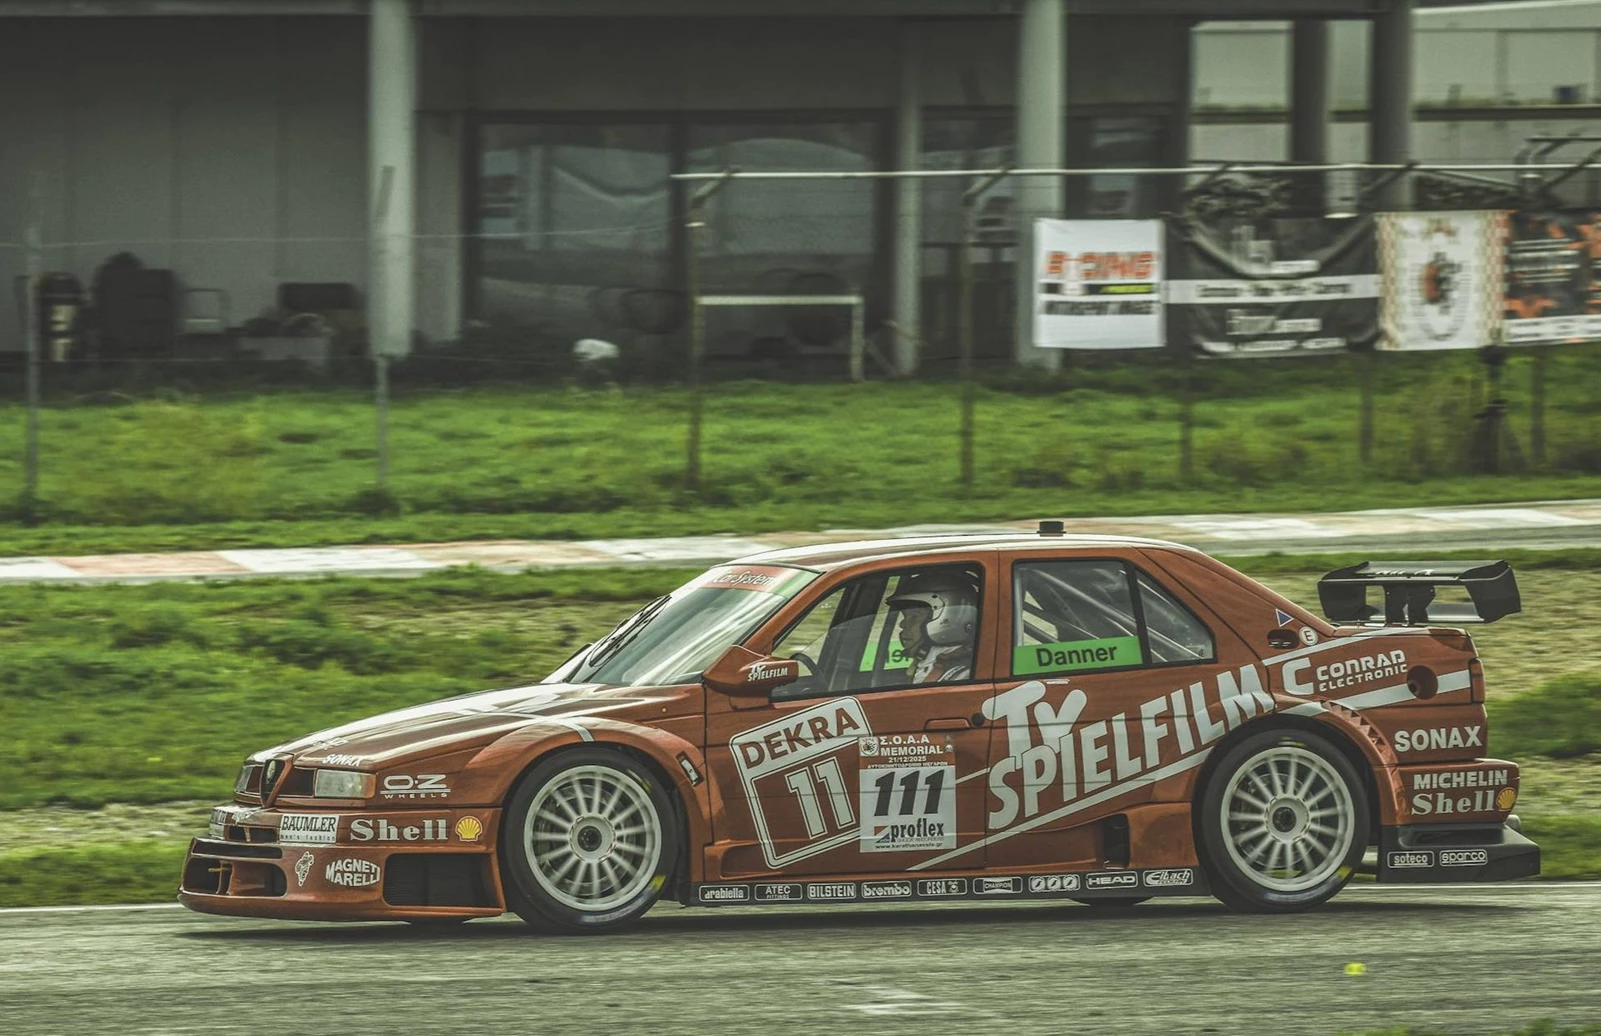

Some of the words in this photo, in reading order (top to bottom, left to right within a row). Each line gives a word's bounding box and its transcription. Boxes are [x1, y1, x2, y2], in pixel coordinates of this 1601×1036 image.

[1036, 645, 1117, 667] Danner
[1316, 649, 1406, 681] CONRAD
[748, 667, 788, 682] SPIELFILM
[1319, 664, 1408, 692] ELECTRONIC
[982, 681, 1087, 769] TV
[739, 707, 860, 769] DEKRA
[988, 664, 1276, 830] SPIELFILM
[1394, 725, 1483, 752] SONAX
[880, 745, 943, 756] MEMORIAL
[1413, 770, 1508, 790] MICHELIN
[785, 757, 856, 839] 11
[873, 769, 945, 817] 111
[1411, 790, 1495, 815] Shell
[350, 818, 448, 841] Shell
[891, 818, 944, 843] proflex
[1394, 853, 1428, 864] soteco
[1442, 852, 1486, 864] sparco
[765, 885, 791, 895] ATEC
[863, 883, 910, 897] brembo
[926, 881, 947, 894] CESA
[985, 881, 1012, 890] CHAMPION
[1088, 875, 1135, 885] HEAD
[704, 887, 744, 899] arabiella
[809, 885, 855, 897] BILSTEIN
